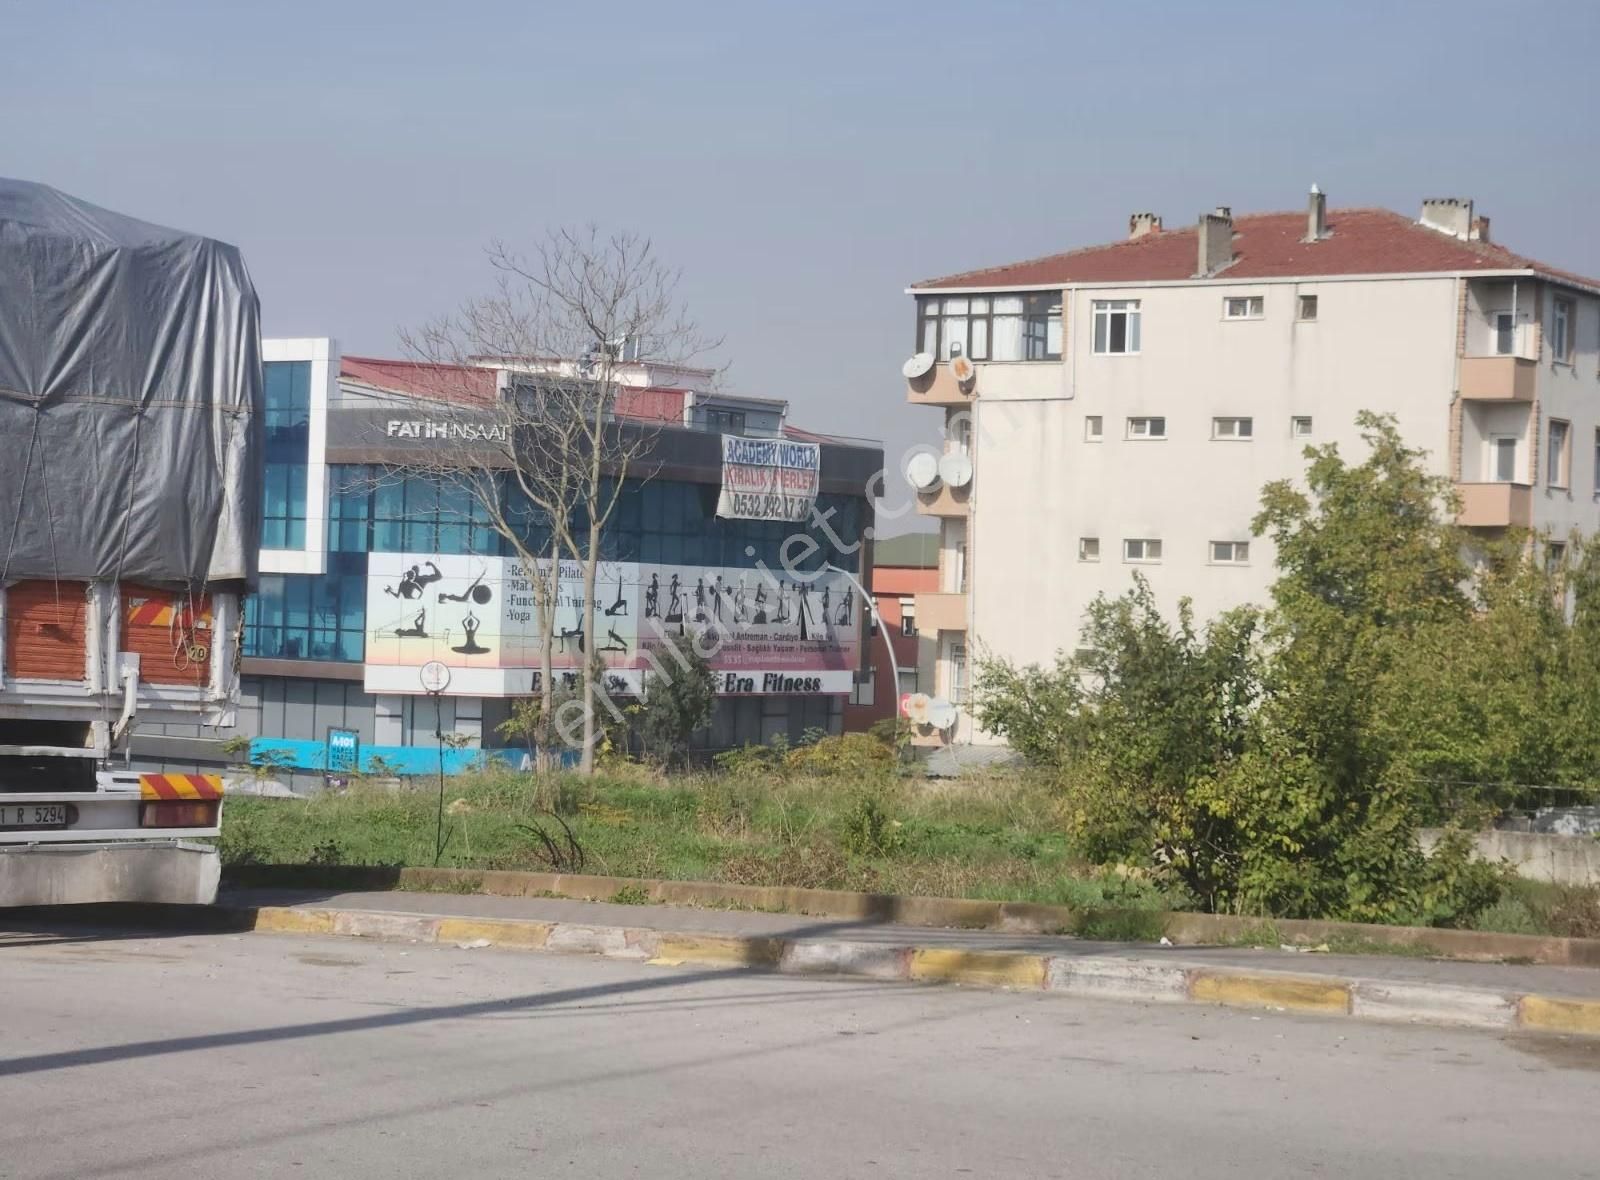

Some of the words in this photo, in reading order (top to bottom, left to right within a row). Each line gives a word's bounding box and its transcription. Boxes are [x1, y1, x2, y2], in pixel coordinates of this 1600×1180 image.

[734, 493, 761, 517] 0532
[725, 672, 754, 692] Era
[762, 672, 822, 692] Fitness
[17, 807, 24, 823] R
[35, 806, 64, 823] 5294
